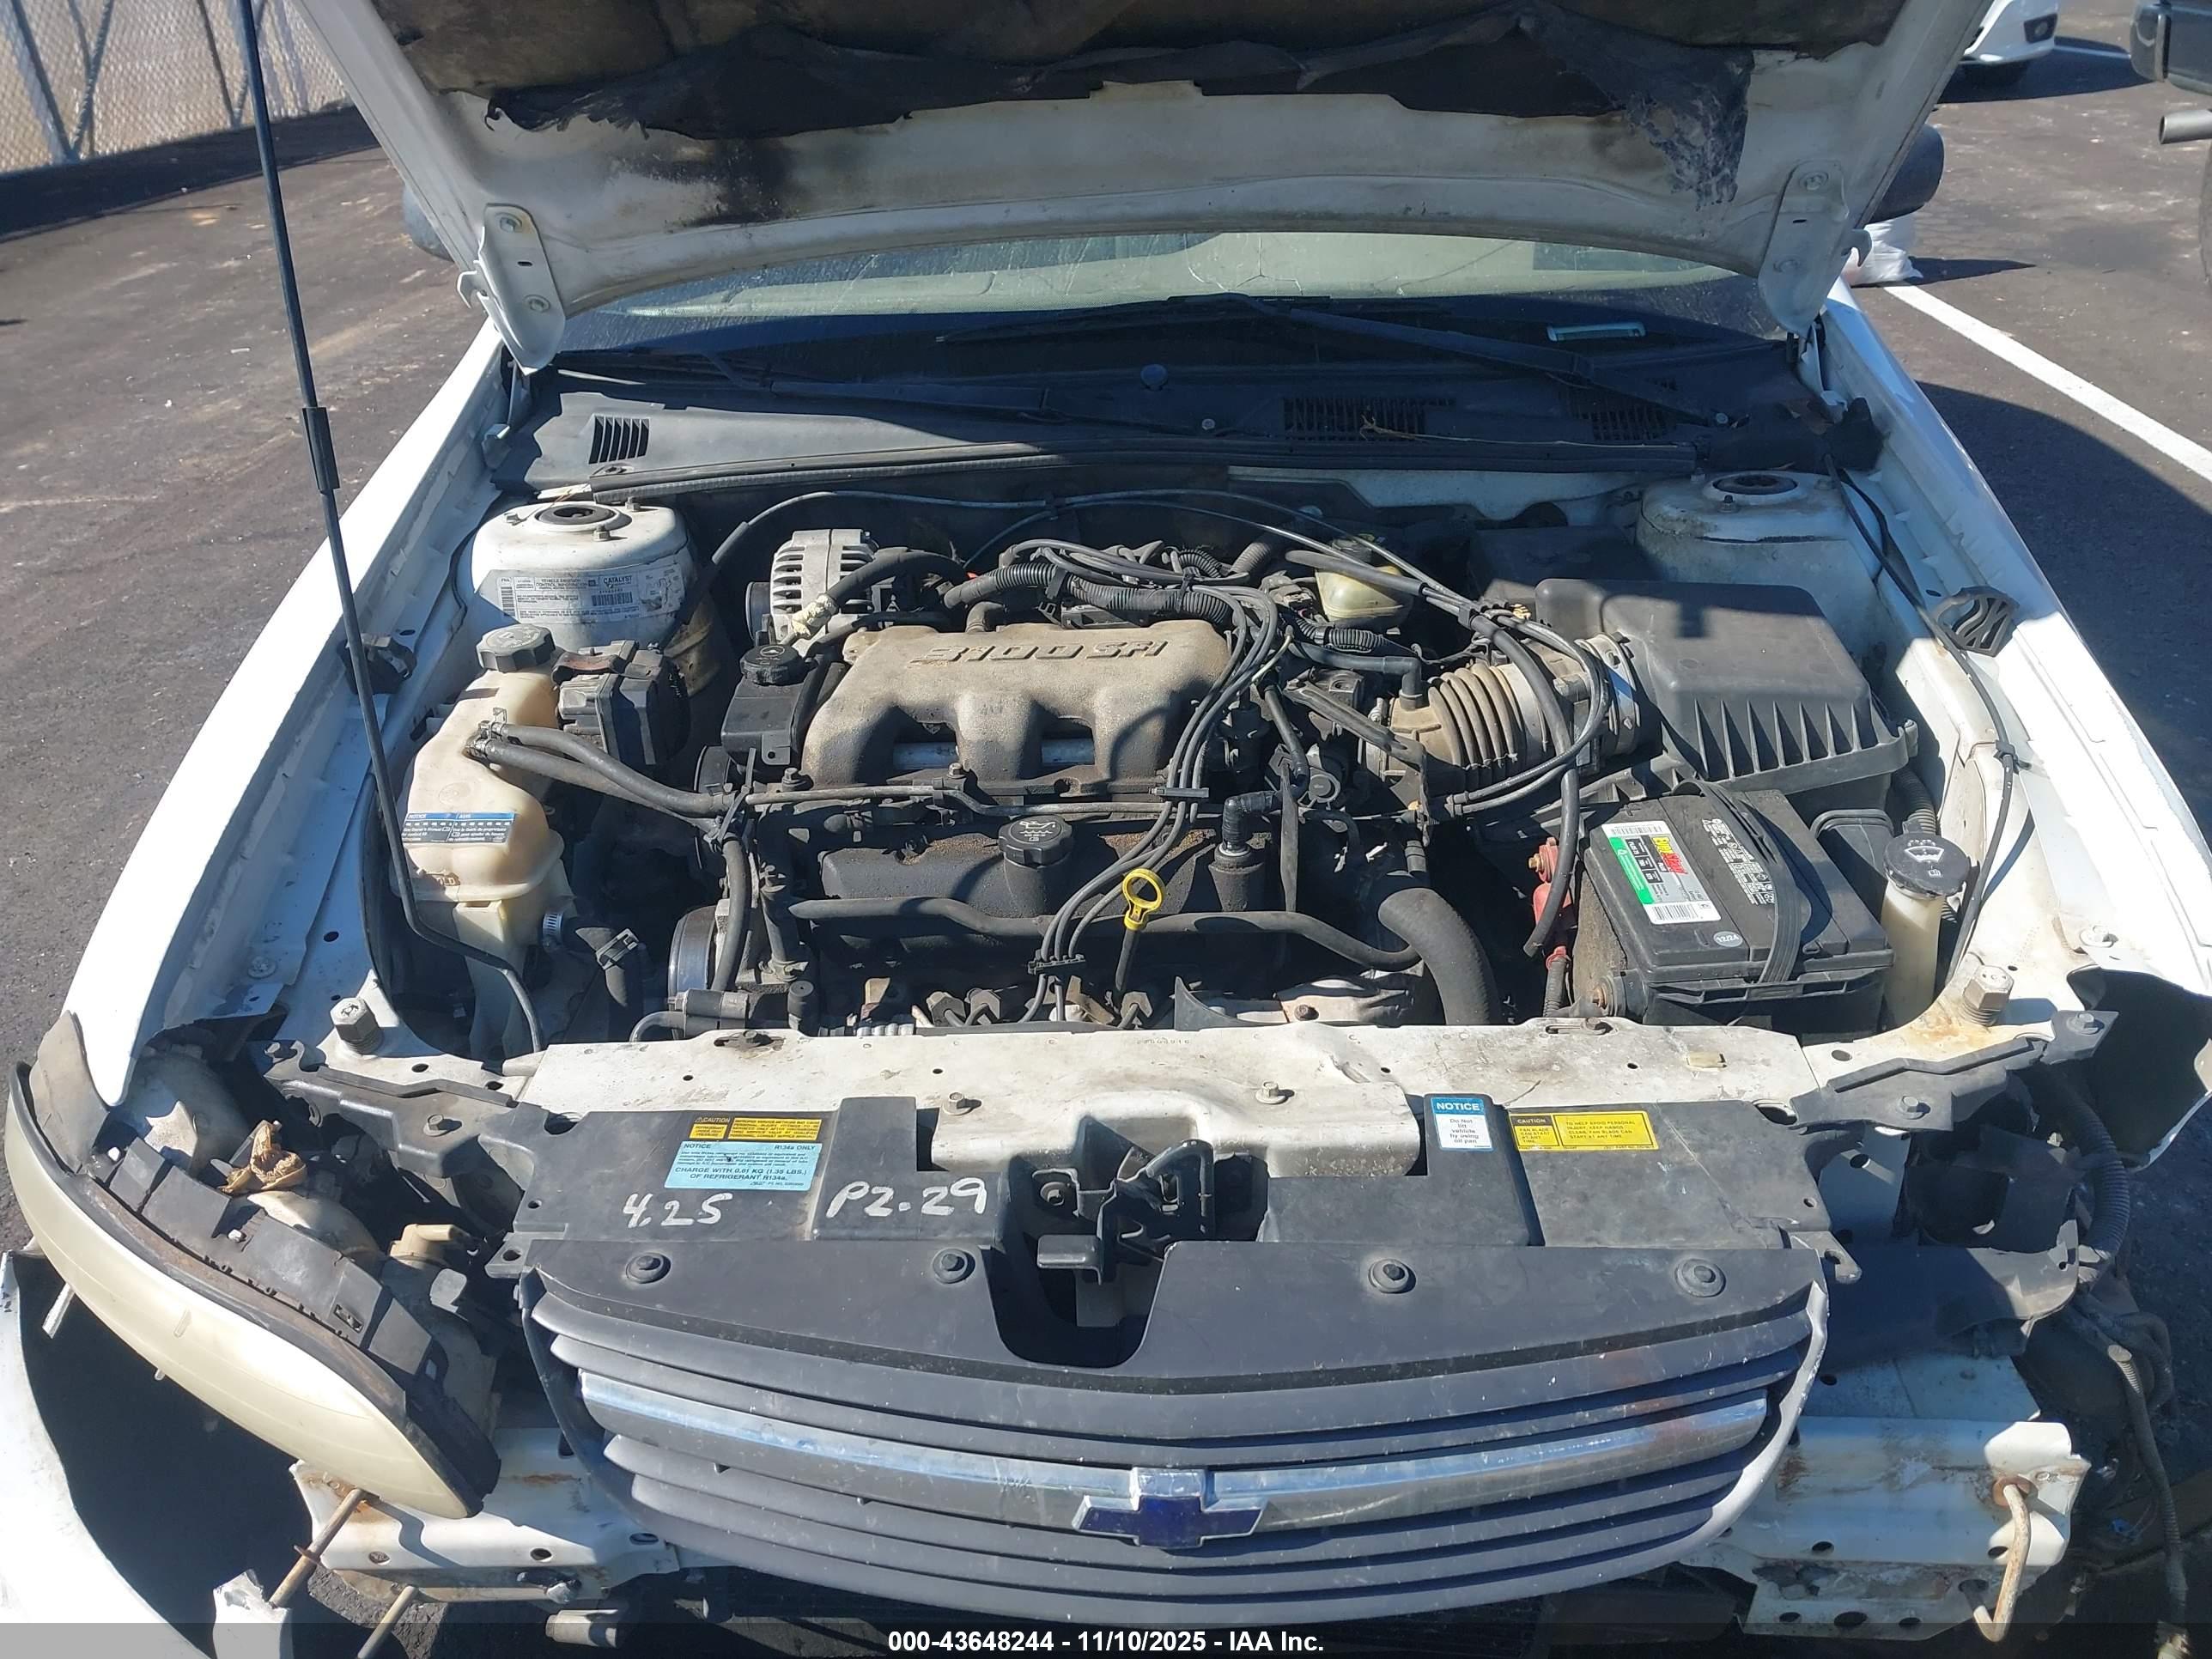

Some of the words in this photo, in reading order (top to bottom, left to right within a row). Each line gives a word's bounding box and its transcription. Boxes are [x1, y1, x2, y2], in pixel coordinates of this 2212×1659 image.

[603, 574, 633, 585] CATALYST
[1085, 641, 1170, 659] SFI
[1436, 1102, 1480, 1111] NOTICE
[825, 1176, 988, 1218] P2.29
